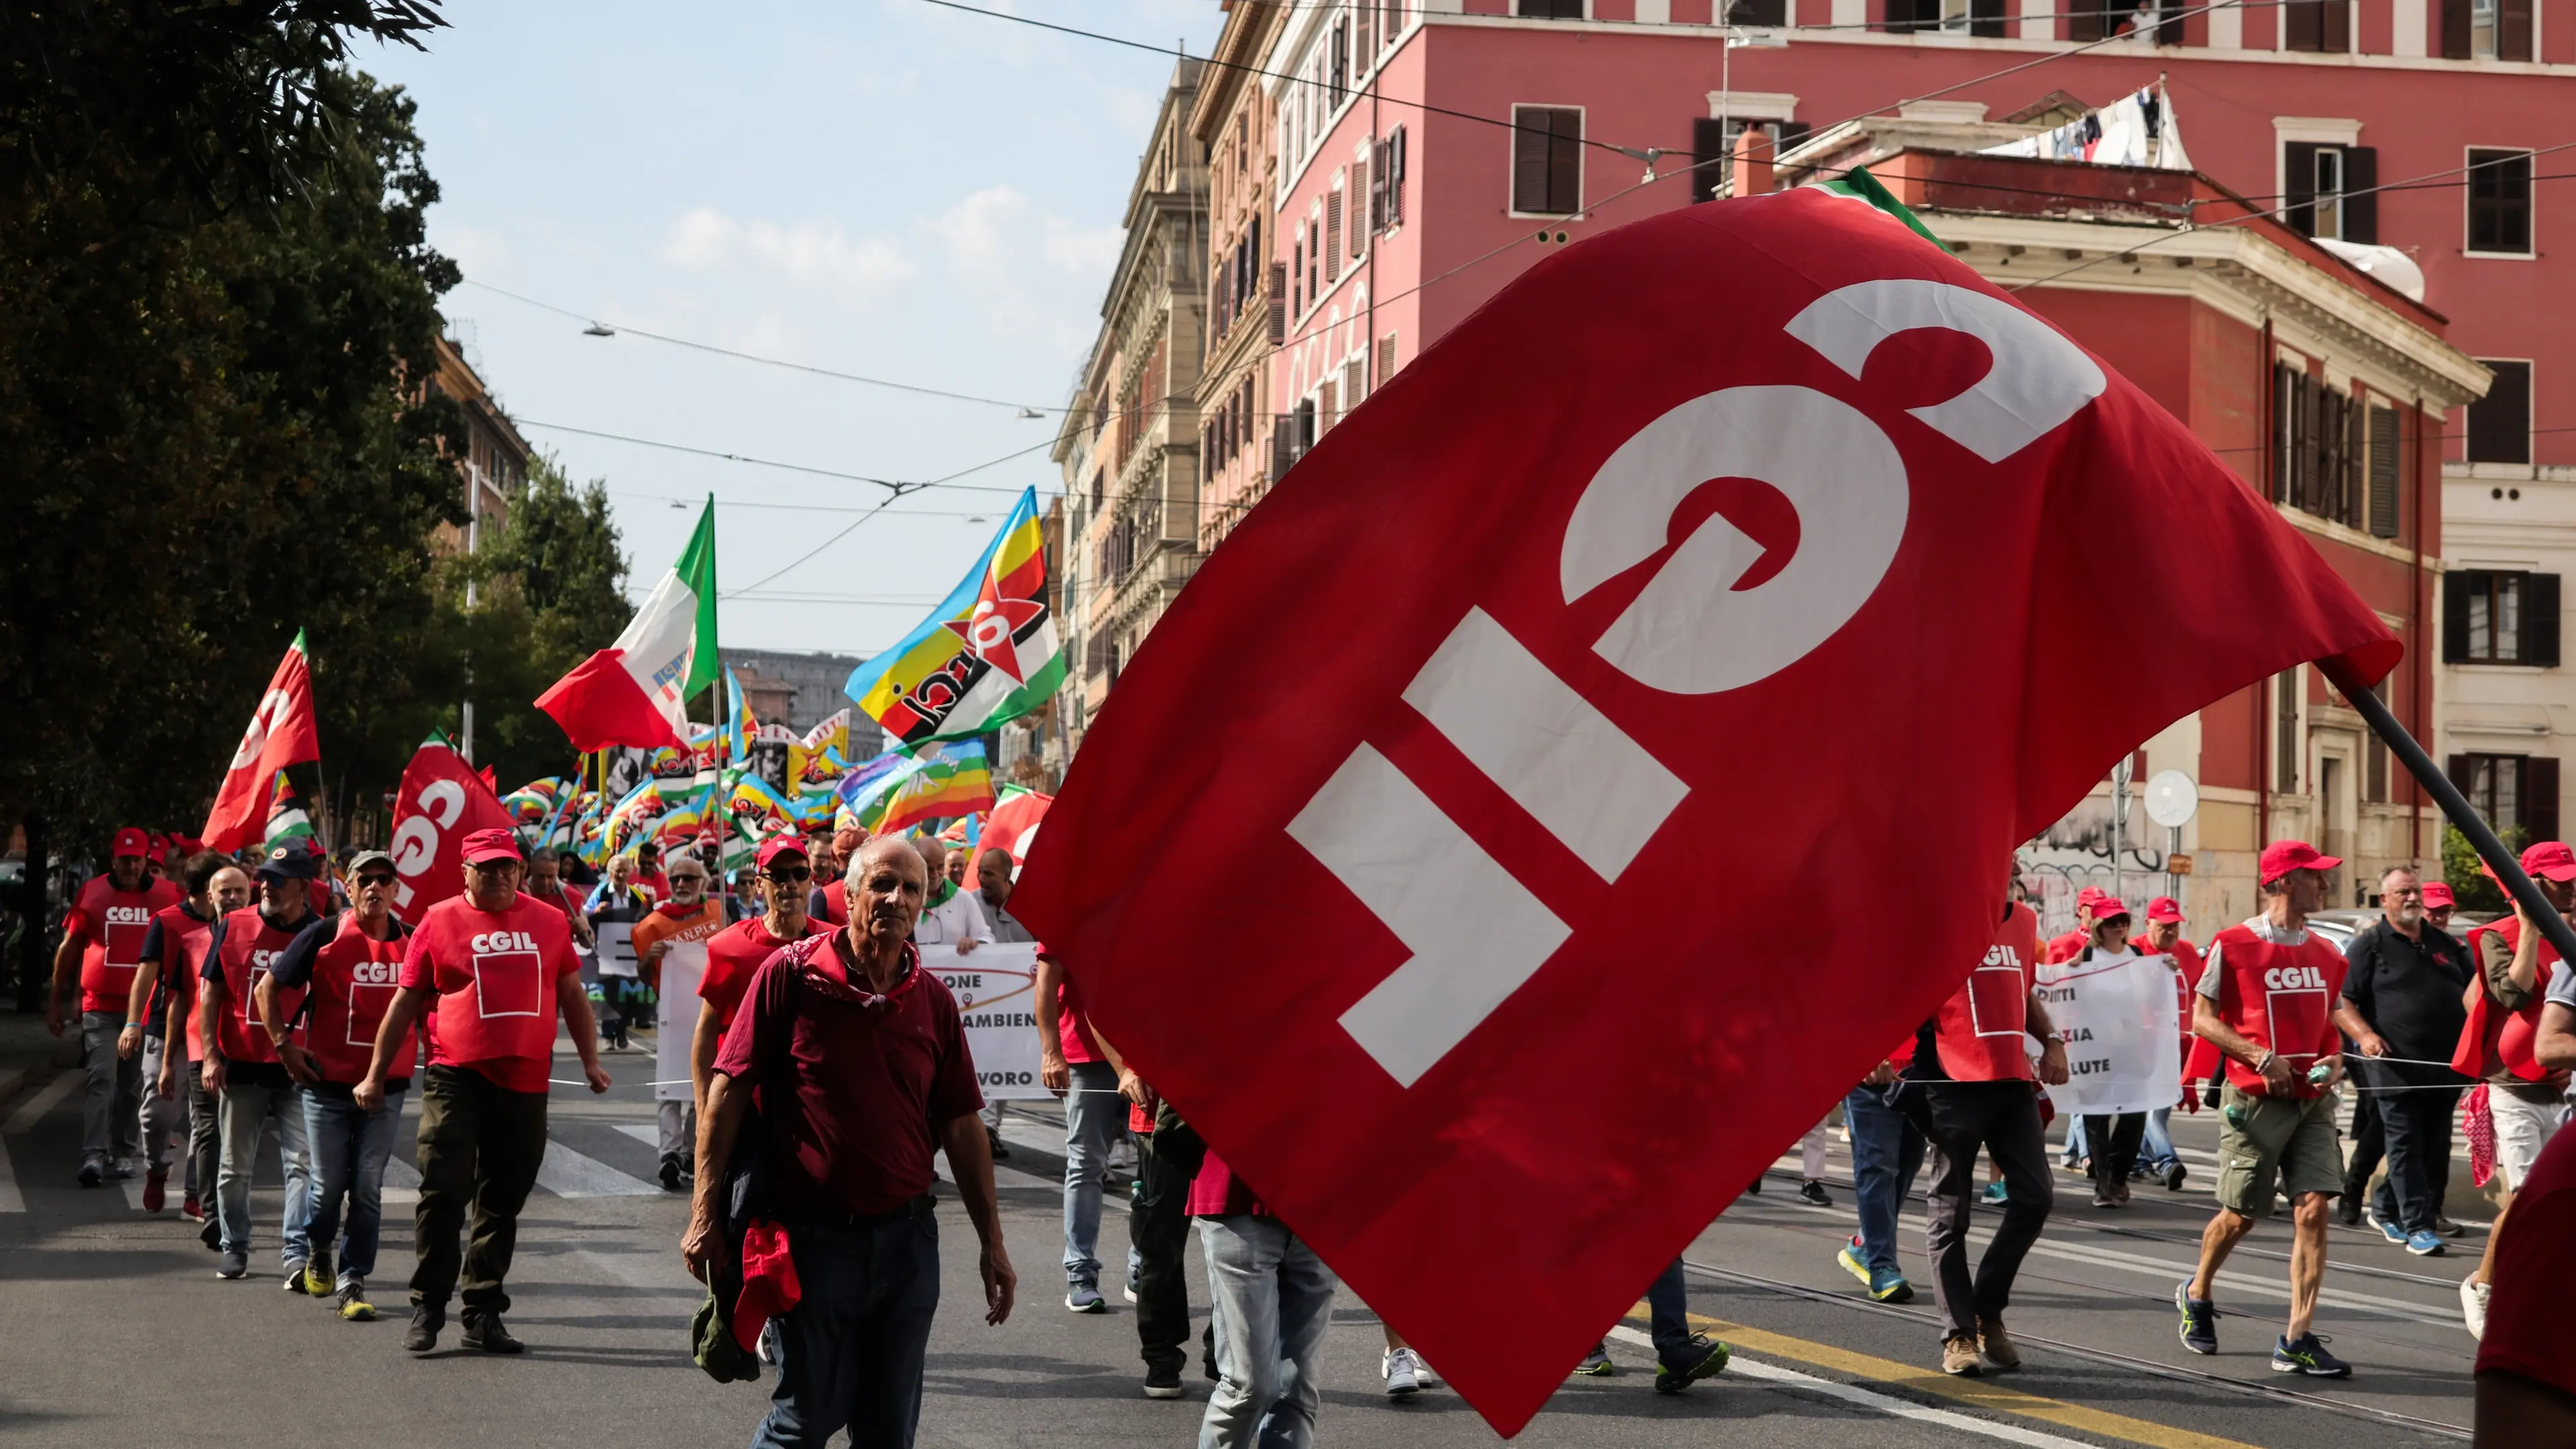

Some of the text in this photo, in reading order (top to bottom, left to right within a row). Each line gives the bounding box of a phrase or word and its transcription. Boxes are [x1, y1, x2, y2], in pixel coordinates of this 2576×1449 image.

[106, 906, 150, 921] CGIL
[472, 930, 538, 953] CGIL
[1979, 944, 2022, 967] GIL
[942, 975, 981, 988] ONE
[2264, 967, 2326, 989] CGIL
[962, 1014, 1037, 1028] AMBIEN
[2061, 1027, 2094, 1042] ZIA
[2070, 1058, 2110, 1075] LUTE
[977, 1072, 1032, 1085] VORO
